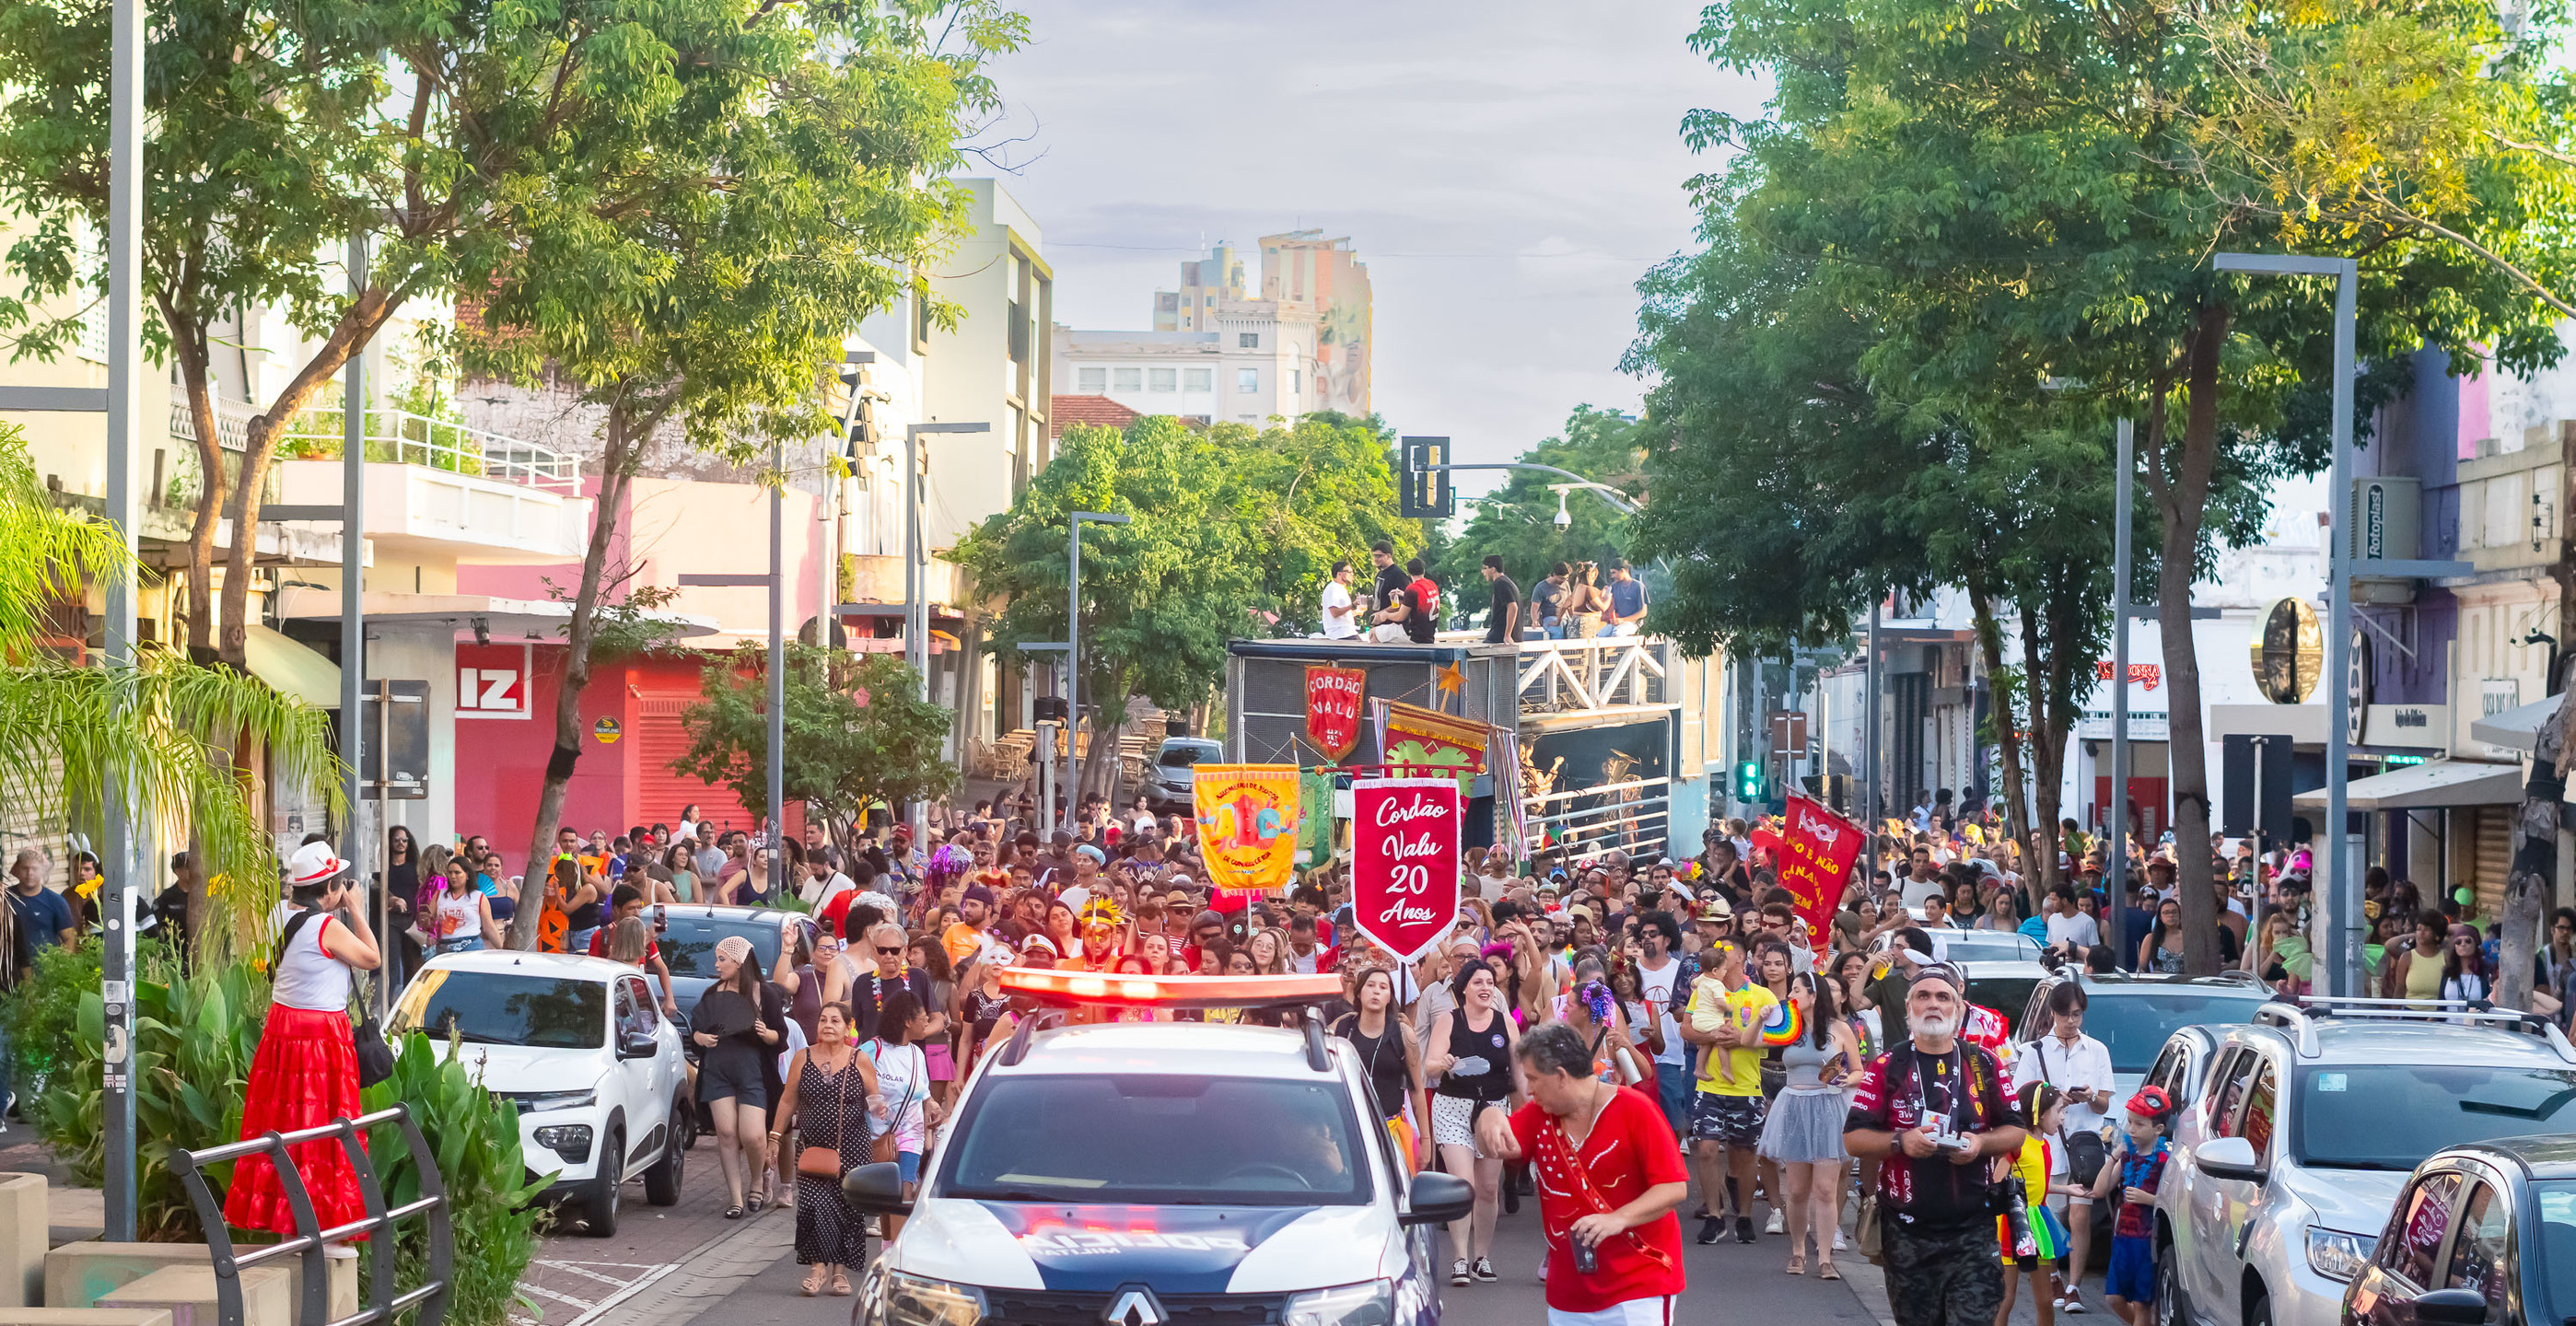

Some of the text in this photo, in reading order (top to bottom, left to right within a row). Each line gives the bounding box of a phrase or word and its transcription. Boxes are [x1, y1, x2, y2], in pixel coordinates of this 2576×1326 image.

[2369, 490, 2384, 556] Rotoplast
[460, 667, 518, 709] IZ
[1309, 676, 1360, 694] CORDÃO
[1312, 701, 1355, 718] VALU
[1376, 793, 1449, 827] Cordão
[1381, 830, 1442, 862] Valu
[1385, 864, 1428, 895] 20
[1814, 855, 1839, 875] NÃO
[1380, 897, 1437, 924] Anos
[1903, 1169, 1913, 1203] CEVA
